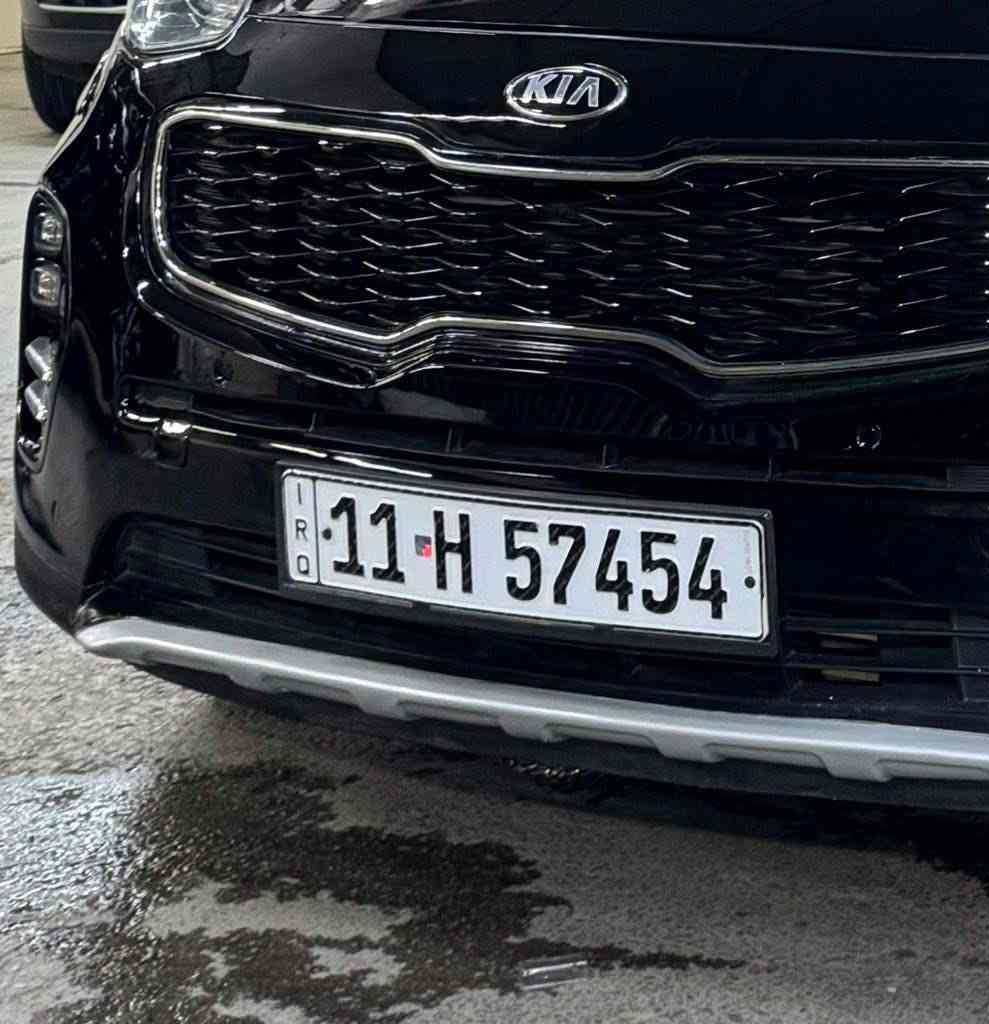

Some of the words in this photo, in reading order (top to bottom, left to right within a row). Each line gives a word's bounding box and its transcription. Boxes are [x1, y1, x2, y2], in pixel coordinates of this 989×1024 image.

[521, 74, 600, 107] KIA
[330, 496, 405, 584] 11
[433, 509, 473, 594] H
[504, 519, 728, 619] 57454
